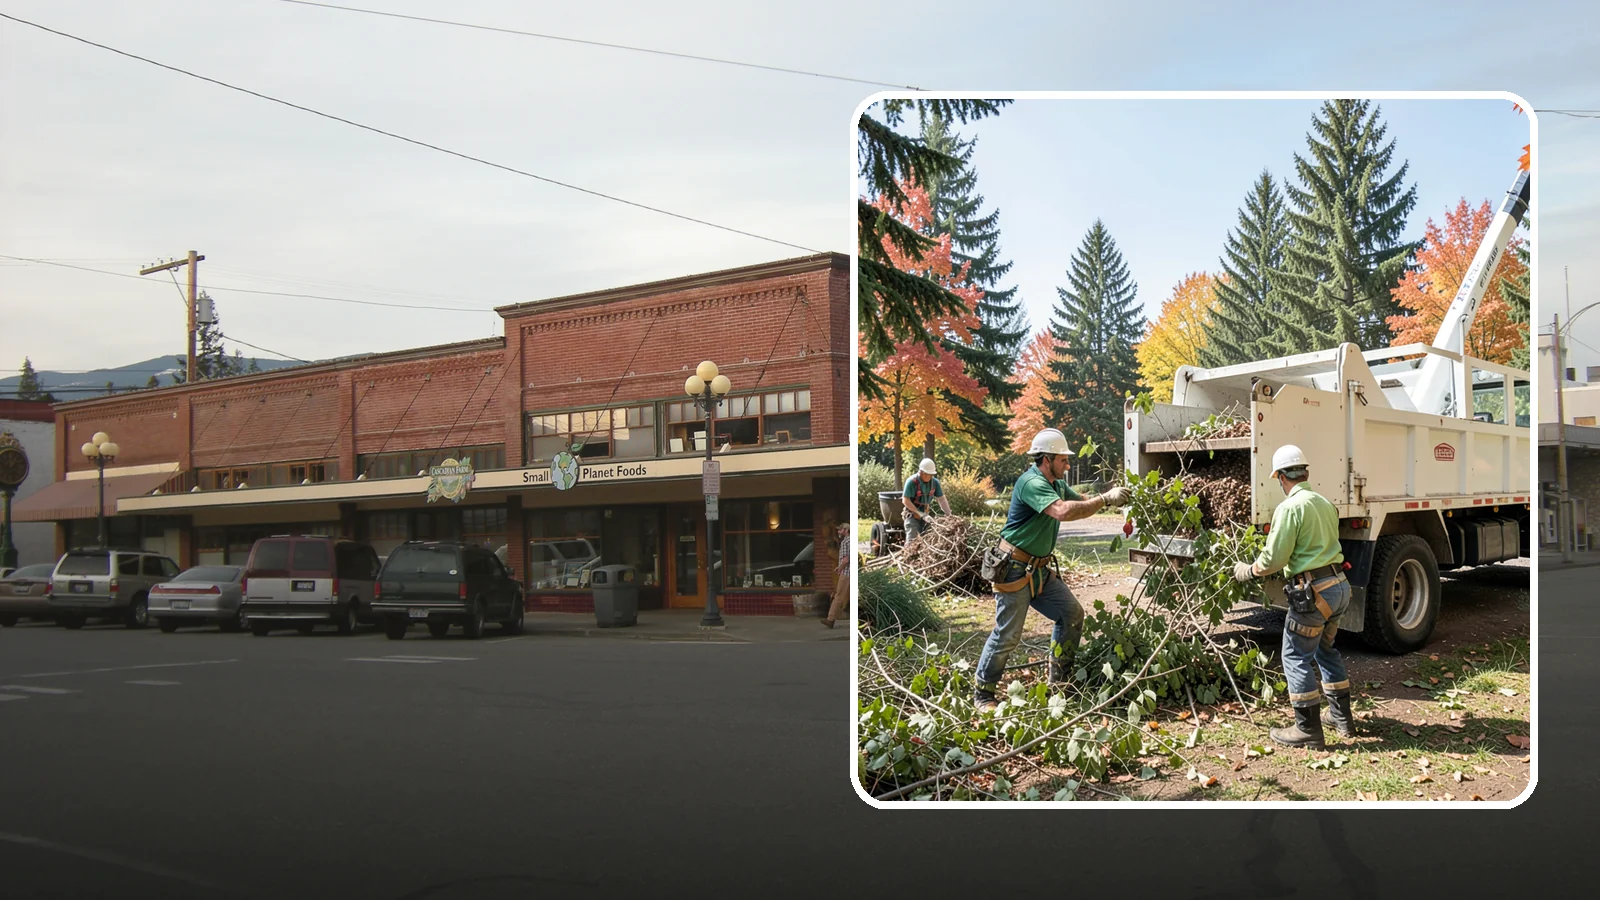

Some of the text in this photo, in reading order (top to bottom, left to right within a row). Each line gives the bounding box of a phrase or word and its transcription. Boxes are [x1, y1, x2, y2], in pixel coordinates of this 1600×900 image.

[523, 464, 646, 482] Small Planet Foods
